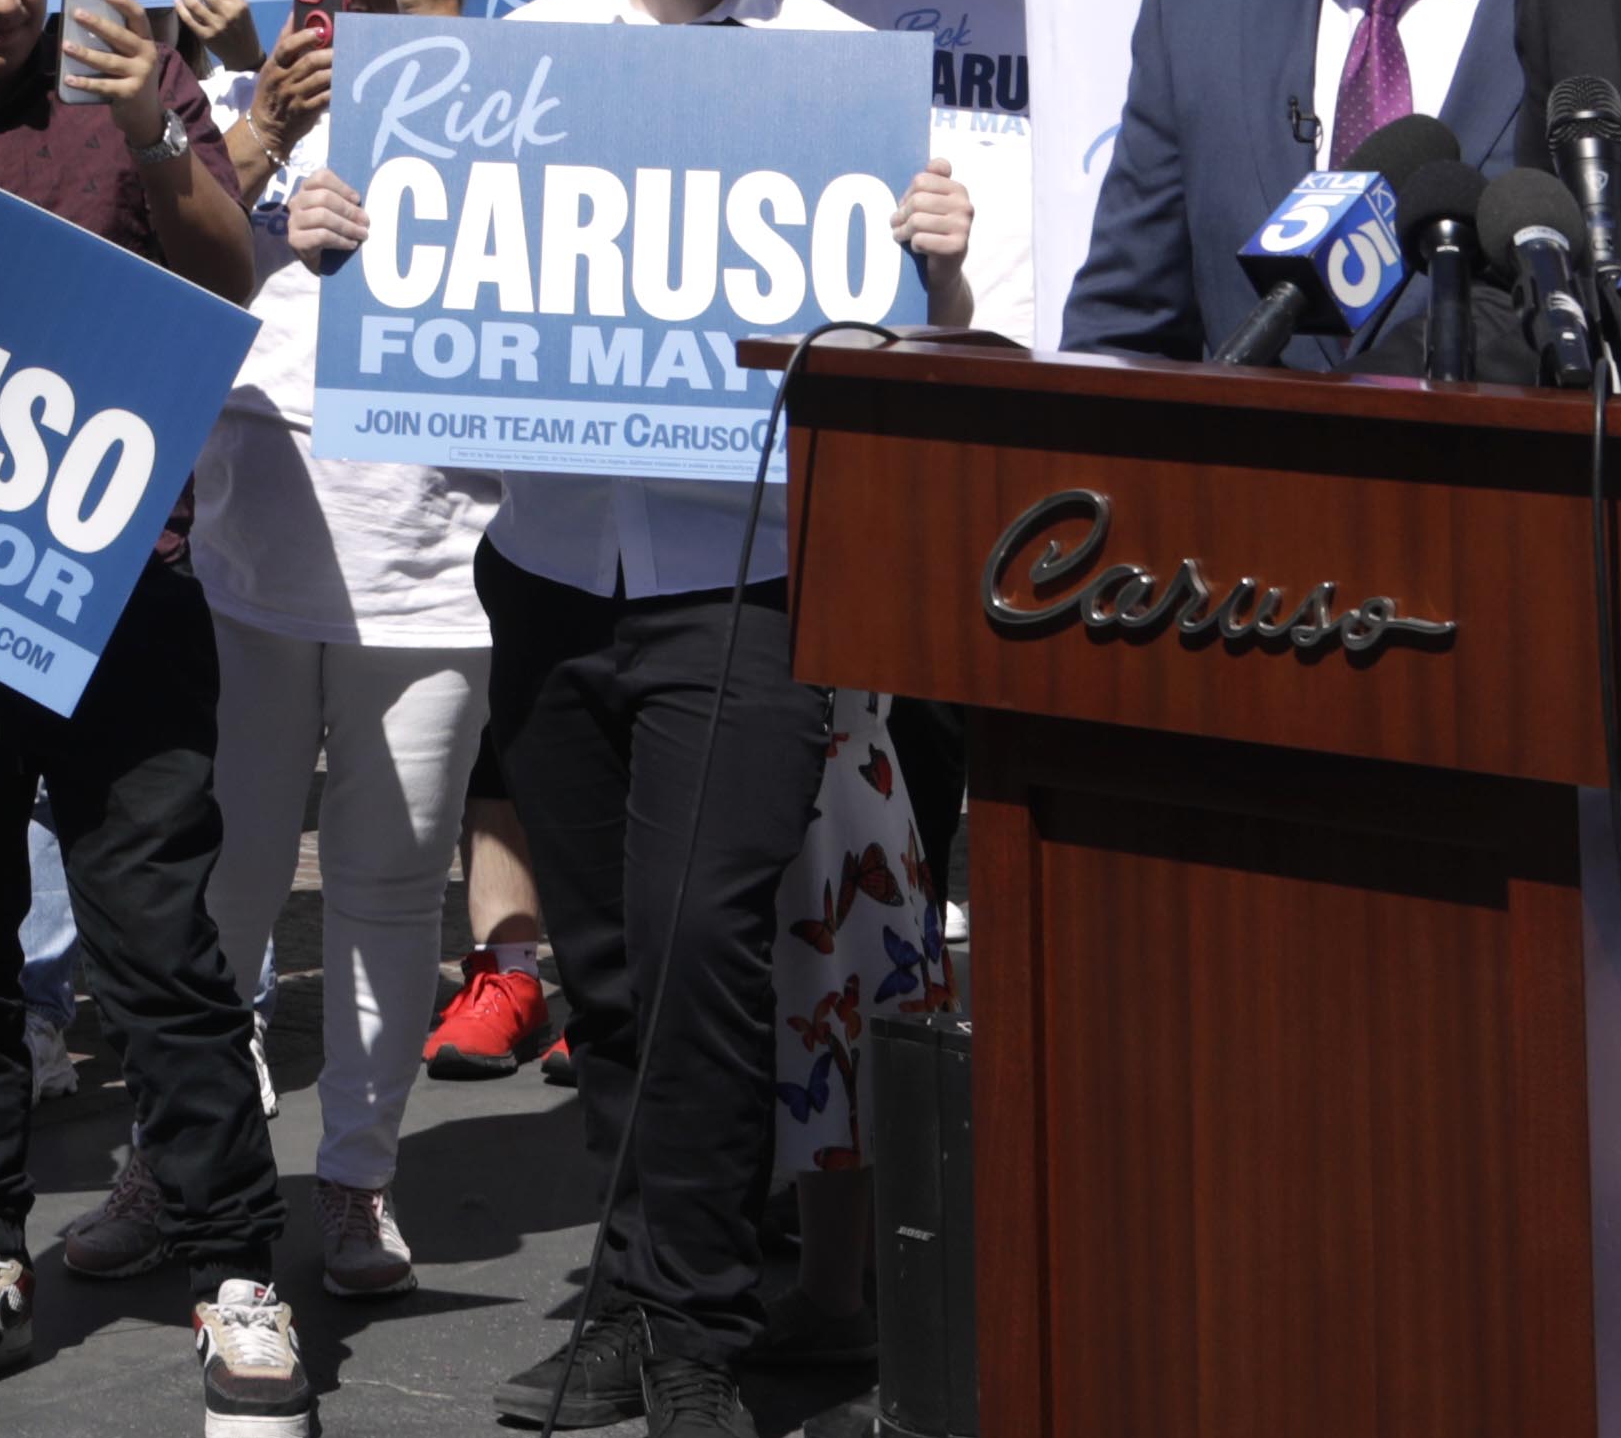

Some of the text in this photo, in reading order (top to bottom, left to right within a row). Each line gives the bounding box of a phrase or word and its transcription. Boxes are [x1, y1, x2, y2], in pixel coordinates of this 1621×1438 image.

[352, 35, 568, 169] Rick
[363, 158, 902, 325] CARUSO
[1260, 195, 1344, 252] 5
[1300, 172, 1368, 190] KTLA
[981, 489, 1457, 666] Caruso
